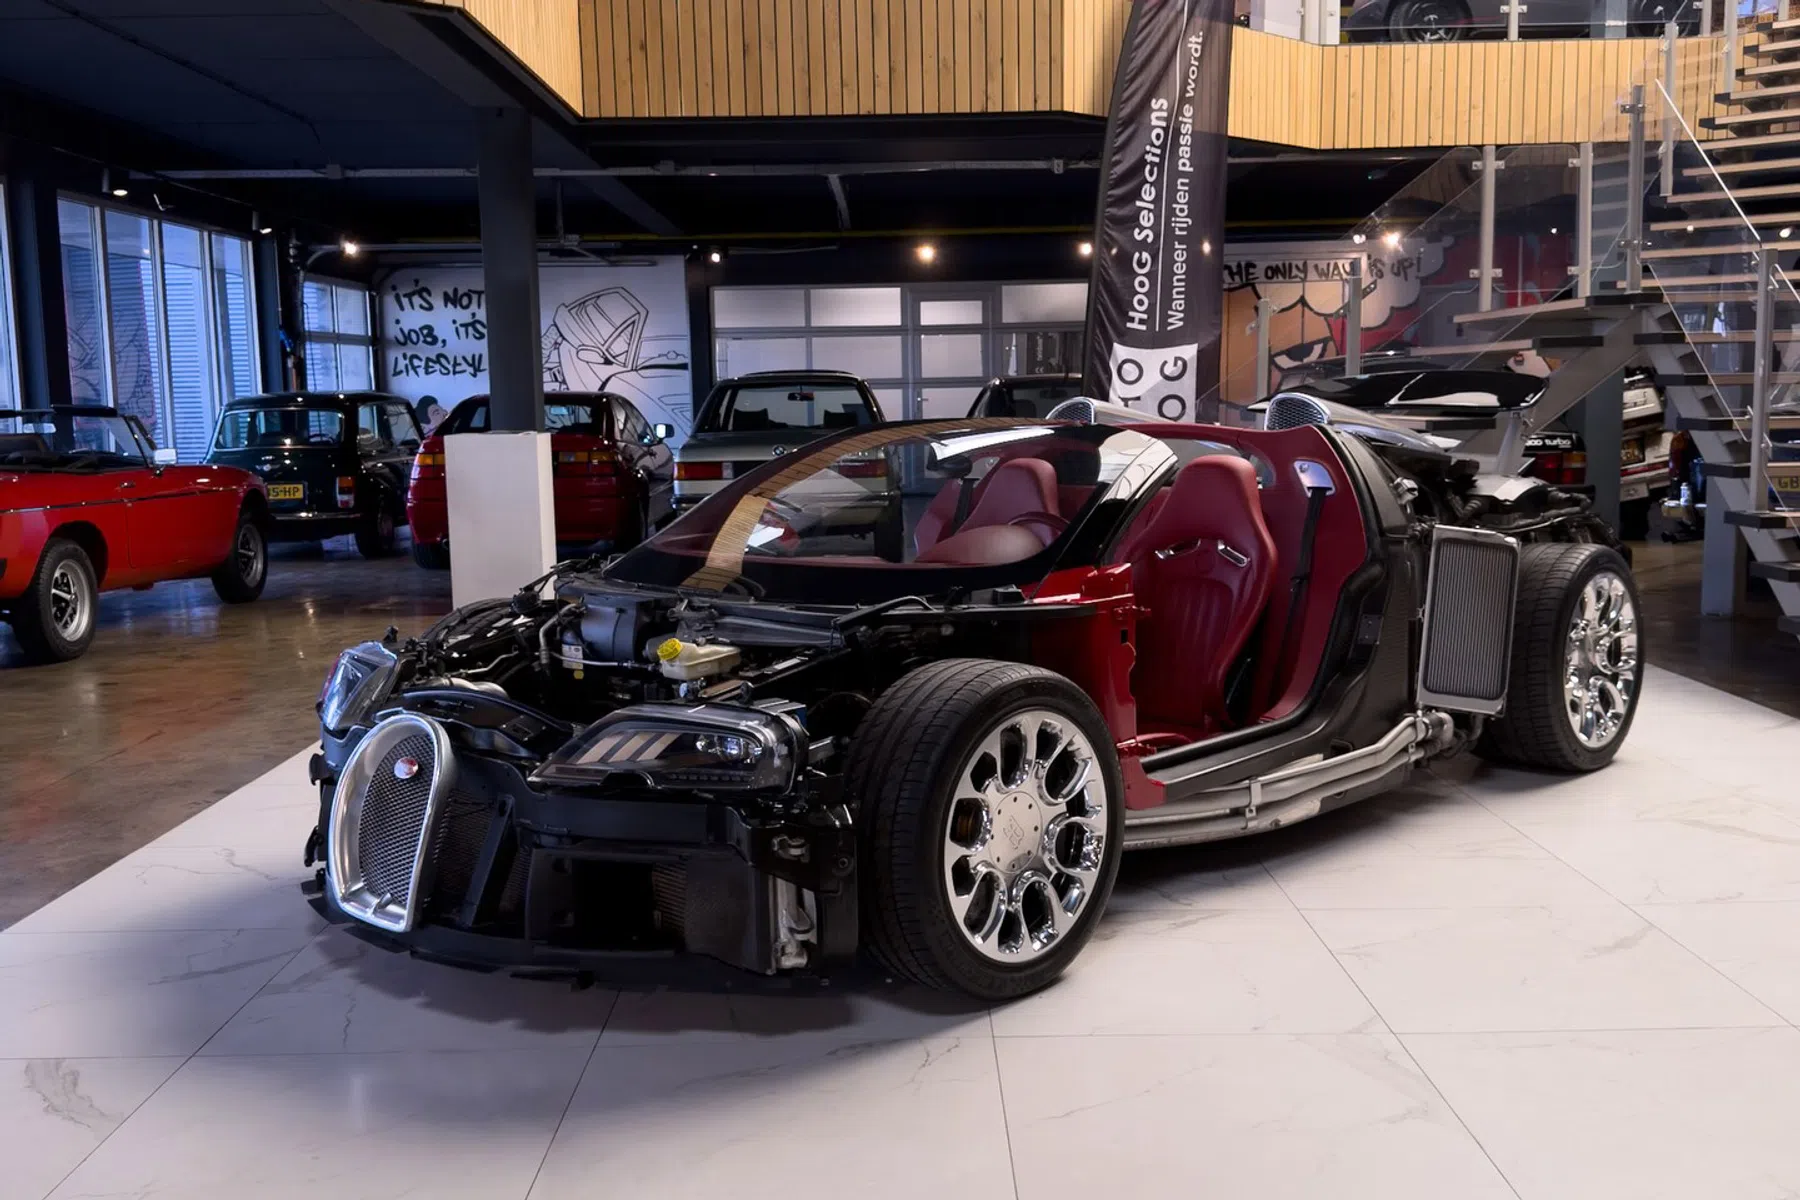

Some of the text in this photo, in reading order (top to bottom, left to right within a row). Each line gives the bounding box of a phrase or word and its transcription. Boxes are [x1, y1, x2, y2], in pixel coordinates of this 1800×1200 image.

[1167, 31, 1204, 331] Wanneer rijden passie wordt.
[1126, 98, 1168, 331] HooG Selections
[1264, 260, 1308, 281] ONLY
[443, 287, 485, 310] NOT
[1544, 437, 1571, 446] turbo
[268, 485, 299, 498] 5-HP
